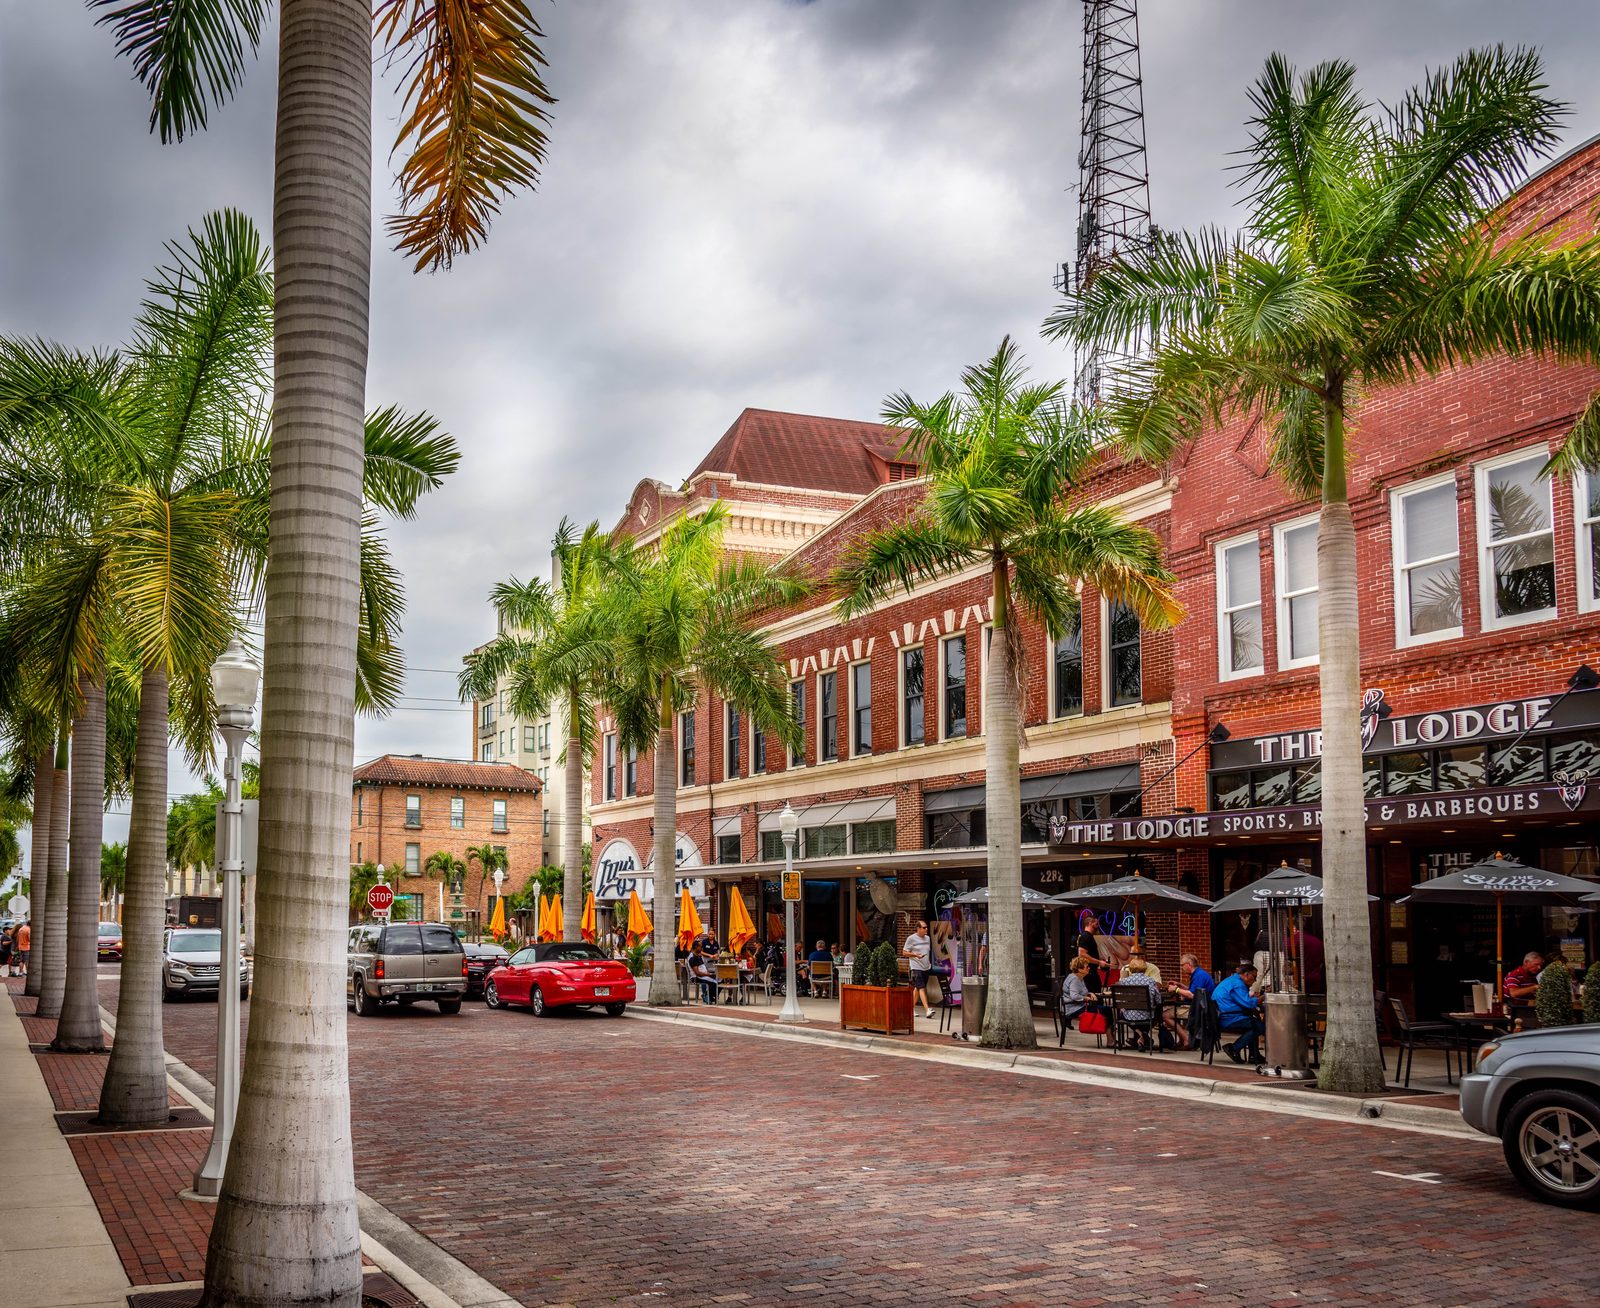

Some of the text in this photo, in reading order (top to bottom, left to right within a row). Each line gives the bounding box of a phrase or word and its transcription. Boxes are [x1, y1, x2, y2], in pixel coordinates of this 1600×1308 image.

[1392, 699, 1553, 747] LODGE
[1223, 813, 1294, 832] SPORTS,
[1381, 805, 1395, 821] &
[1407, 793, 1539, 819] BARBEQUES
[1068, 817, 1209, 843] THE LODGE
[1429, 852, 1473, 867] THE
[784, 874, 789, 882] 2
[1040, 870, 1064, 883] 2282
[1462, 874, 1559, 887] Silver
[370, 892, 392, 902] STOP
